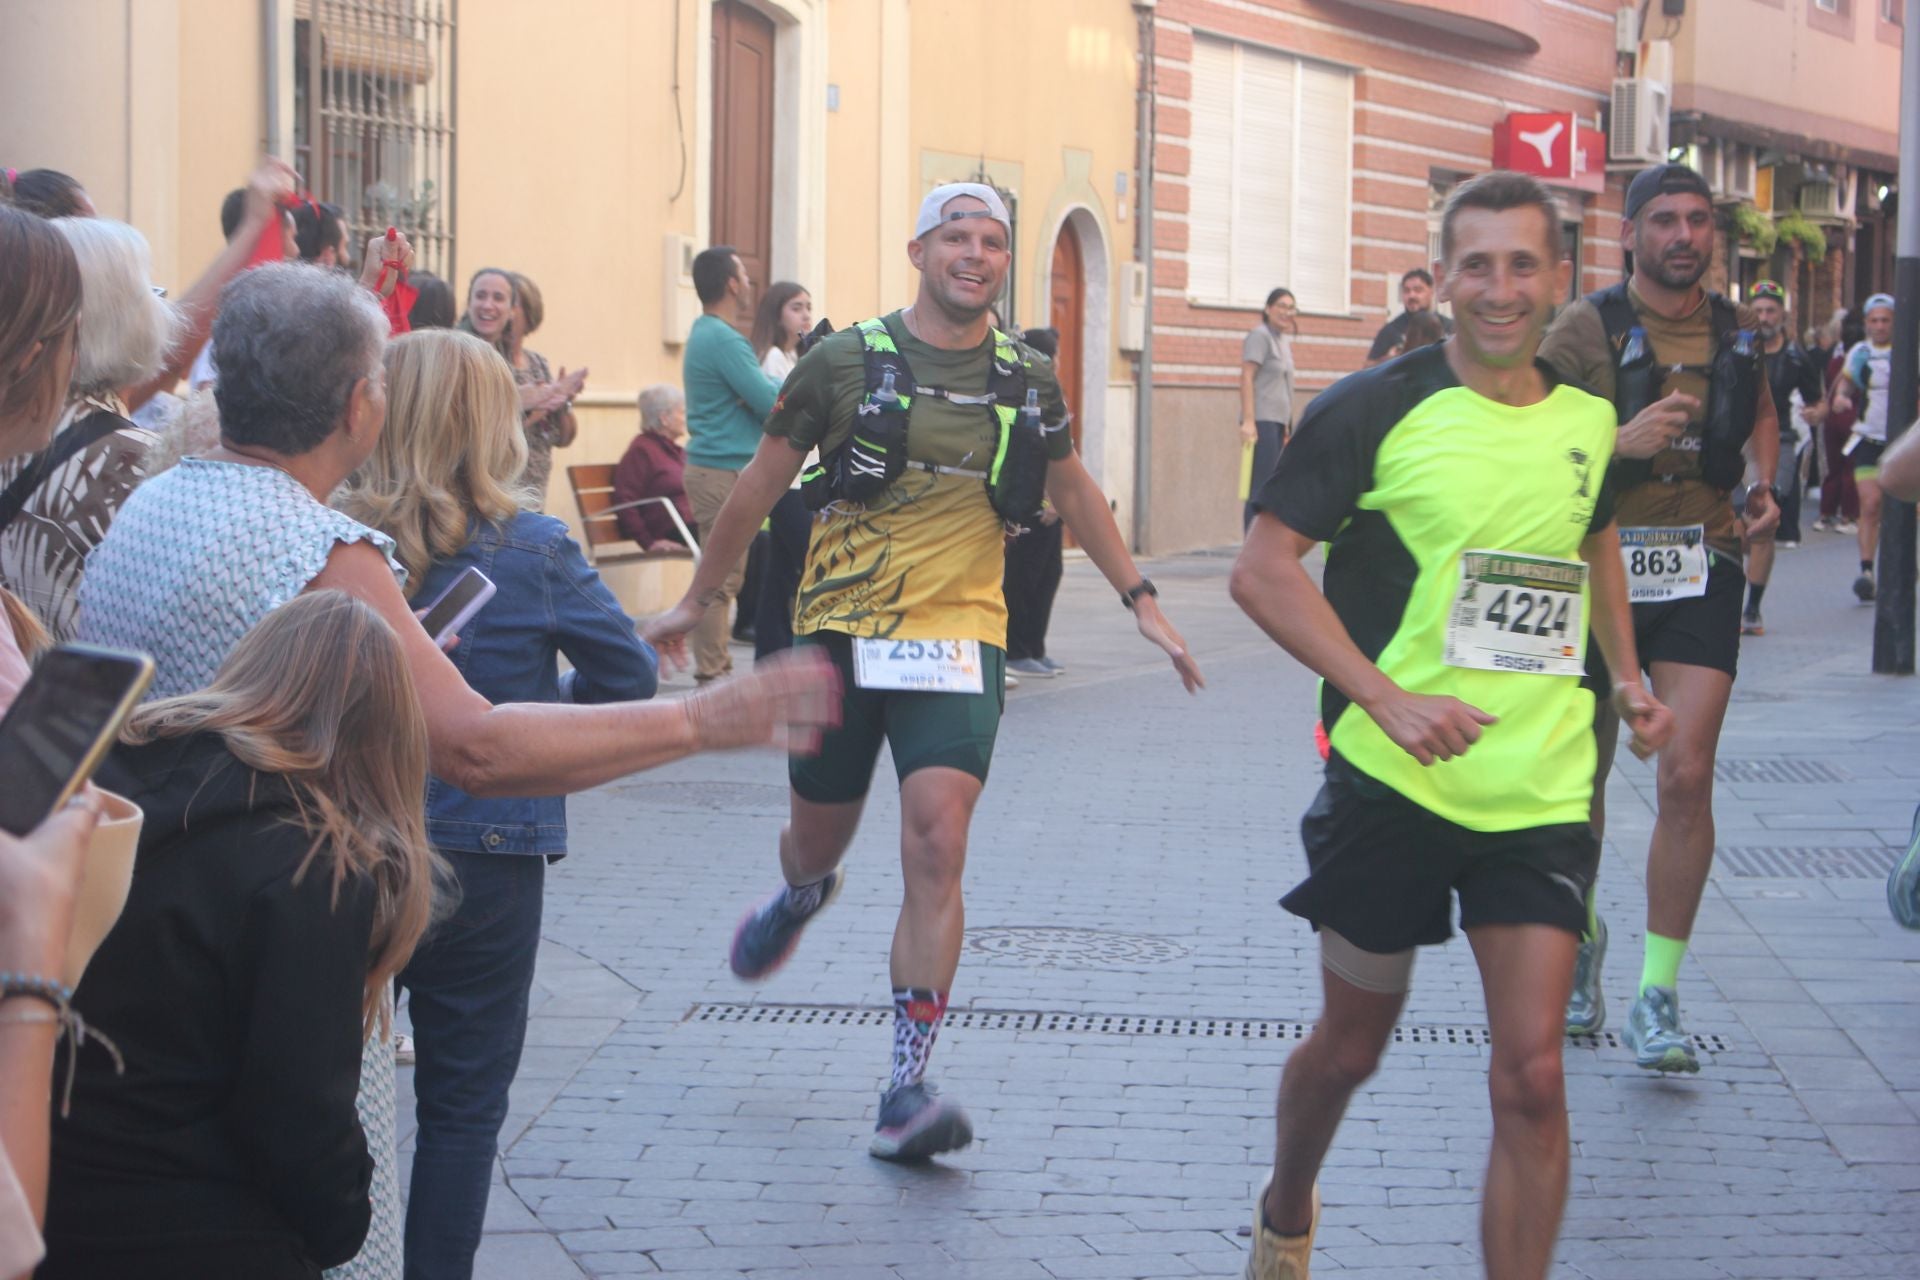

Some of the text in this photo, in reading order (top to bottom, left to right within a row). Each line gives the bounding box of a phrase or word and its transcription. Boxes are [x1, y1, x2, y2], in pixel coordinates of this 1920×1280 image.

[1631, 548, 1682, 577] 863
[1486, 589, 1570, 638] 4224
[888, 640, 961, 660] 2533
